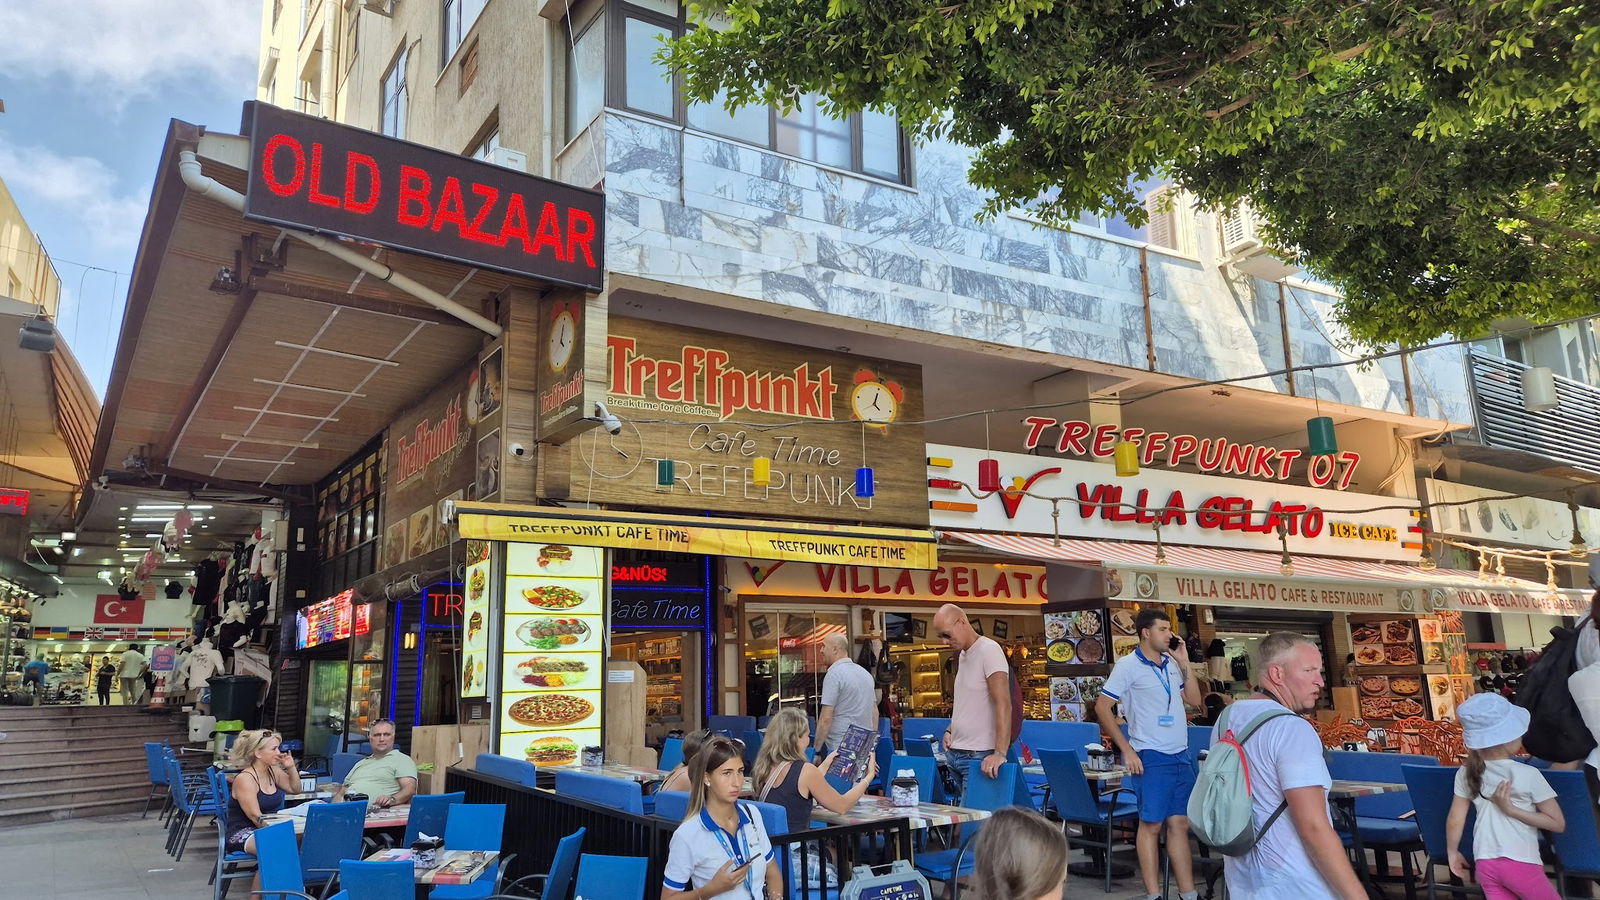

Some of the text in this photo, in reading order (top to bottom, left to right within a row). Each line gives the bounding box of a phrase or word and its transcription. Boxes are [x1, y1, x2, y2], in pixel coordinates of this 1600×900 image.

[262, 134, 597, 268] OLD BAZAAR
[540, 368, 584, 416] Treffpunkt
[607, 334, 838, 422] Treffpunkt
[607, 396, 637, 408] Break
[637, 399, 658, 410] time
[660, 402, 673, 412] for
[675, 405, 681, 413] a
[397, 392, 461, 484] Treffpunkt
[688, 424, 756, 457] Cafe
[1025, 416, 1361, 491] TREFFPUNKT 07
[1077, 482, 1324, 538] VILLA GELATO
[509, 524, 689, 544] TREFFPUNKT CAFE TIME
[1330, 523, 1399, 542] ICE CAFE
[769, 540, 906, 560] TREFFPUNKT CAFE TIME
[816, 564, 915, 595] VILLA
[1224, 581, 1277, 601] GELATO
[1281, 588, 1307, 602] CAFE
[1310, 590, 1318, 602] &
[1322, 590, 1384, 607] RESTAURANT
[611, 599, 701, 620] Cafe Time
[1490, 593, 1530, 608] GELATO
[1531, 599, 1552, 610] CAFE
